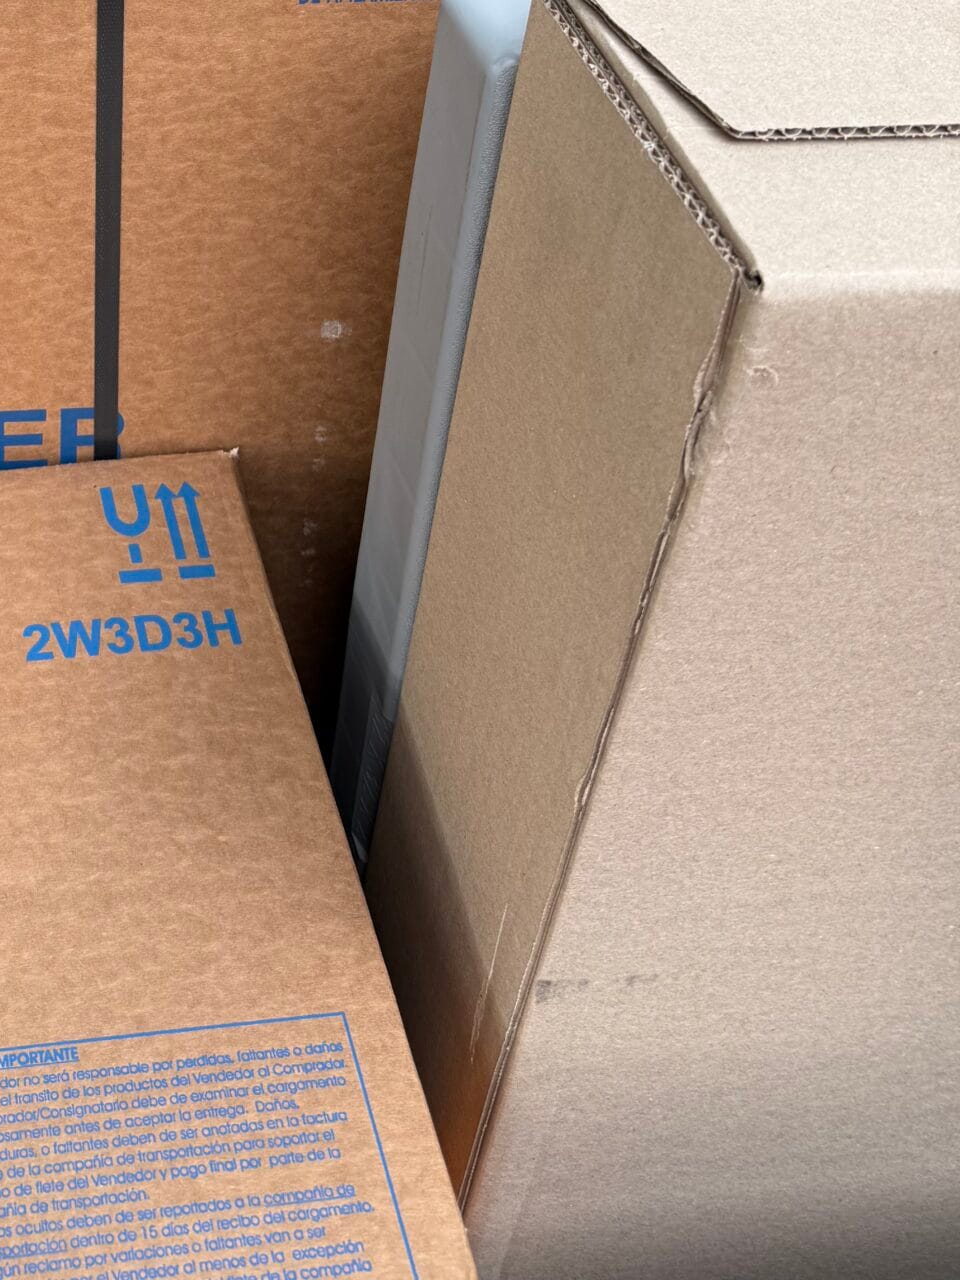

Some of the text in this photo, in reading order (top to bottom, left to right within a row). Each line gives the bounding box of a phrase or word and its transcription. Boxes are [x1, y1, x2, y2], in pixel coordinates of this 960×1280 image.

[22, 608, 243, 663] 2W3D3H
[23, 1077, 40, 1087] no
[293, 1048, 303, 1057] o
[0, 1096, 12, 1107] el
[62, 1089, 81, 1100] de
[258, 1067, 271, 1079] al
[170, 1094, 189, 1106] de
[249, 1084, 265, 1099] el
[42, 1147, 49, 1157] o
[160, 1131, 177, 1143] de
[265, 1120, 284, 1130] en
[286, 1118, 300, 1128] la
[103, 1120, 122, 1132] de
[178, 1111, 193, 1122] la
[7, 1167, 26, 1179] de
[28, 1166, 41, 1177] la
[116, 1154, 136, 1166] de
[322, 1130, 336, 1142] el
[14, 1185, 32, 1198] de
[160, 1171, 167, 1181] y
[305, 1151, 326, 1163] de
[326, 1149, 341, 1160] la
[30, 1202, 49, 1214] de
[115, 1211, 134, 1223] de
[233, 1199, 246, 1209] a
[247, 1196, 261, 1207] la
[335, 1185, 356, 1197] de
[117, 1230, 138, 1242] de
[142, 1227, 159, 1239] 15
[191, 1243, 202, 1254] o
[293, 1230, 304, 1242] a
[183, 1262, 197, 1275] al
[248, 1253, 270, 1268] de
[271, 1252, 286, 1265] la
